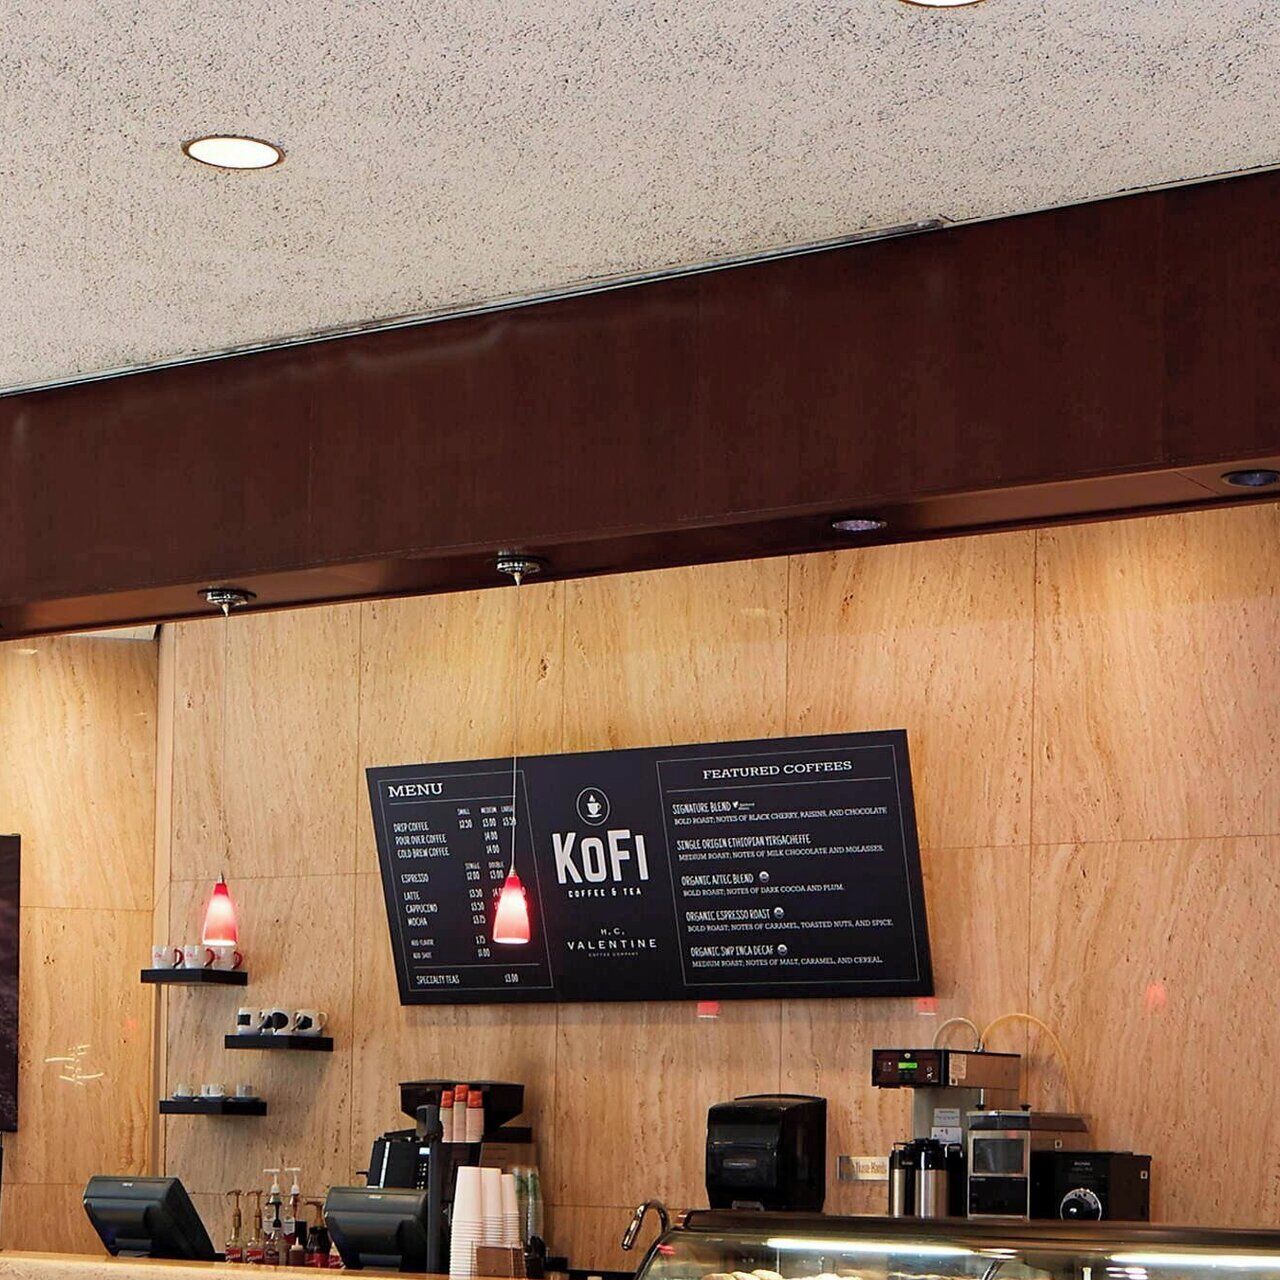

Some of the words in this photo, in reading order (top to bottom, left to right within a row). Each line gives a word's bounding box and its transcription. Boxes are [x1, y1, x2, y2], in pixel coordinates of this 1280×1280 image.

[702, 764, 780, 780] FEATURED
[783, 760, 853, 775] COFFEES
[388, 782, 443, 798] MENU
[672, 801, 710, 815] SIGNATURE
[710, 800, 732, 813] BLEND
[674, 817, 693, 826] BOLD
[716, 815, 738, 824] NOTES
[738, 814, 748, 822] OF
[748, 813, 770, 821] BLACK
[828, 809, 844, 817] AND
[408, 821, 429, 832] COFFEE
[394, 835, 411, 846] POUR
[410, 834, 426, 845] OVER
[426, 833, 447, 844] COFFEE
[676, 839, 701, 851] SINGLE
[701, 838, 728, 850] ORIGIN
[728, 836, 765, 849] ETHIOPIAN
[397, 849, 412, 859] COLD
[412, 848, 428, 858] BREW
[428, 847, 450, 858] COFFEE
[678, 853, 707, 862] MEDIUM
[732, 851, 755, 859] NOTES
[756, 850, 765, 858] OF
[766, 849, 785, 857] MILK
[785, 847, 828, 857] CHOCOLATE
[828, 846, 845, 854] AND
[400, 873, 429, 884] ESPRESSO
[681, 875, 712, 887] ORGANIC
[712, 874, 732, 885] AZTEC
[732, 873, 754, 884] BLEND
[403, 891, 420, 901] LATTE
[568, 889, 606, 898] COFFEE
[623, 887, 642, 896] TEA
[683, 889, 701, 897] BOLD
[726, 887, 750, 895] NOTES
[760, 886, 780, 894] DARK
[780, 885, 806, 893] COCOA
[806, 884, 823, 892] AND
[685, 911, 716, 922] ORGANIC
[716, 909, 749, 921] ESPRESSO
[749, 908, 771, 920] ROAST
[407, 917, 428, 927] MOCHA
[687, 925, 706, 933] BOLD
[731, 923, 754, 931] NOTES
[801, 920, 833, 929] TOASTED
[855, 919, 871, 927] AND
[567, 938, 658, 950] VALENTINE
[690, 946, 720, 957] ORGANIC
[735, 945, 753, 956] INCA
[753, 944, 774, 955] DECAF
[745, 958, 768, 967] NOTES
[768, 958, 778, 966] OF
[837, 956, 853, 965] AND
[416, 974, 445, 985] SPECIALTY
[445, 973, 460, 984] TEAS
